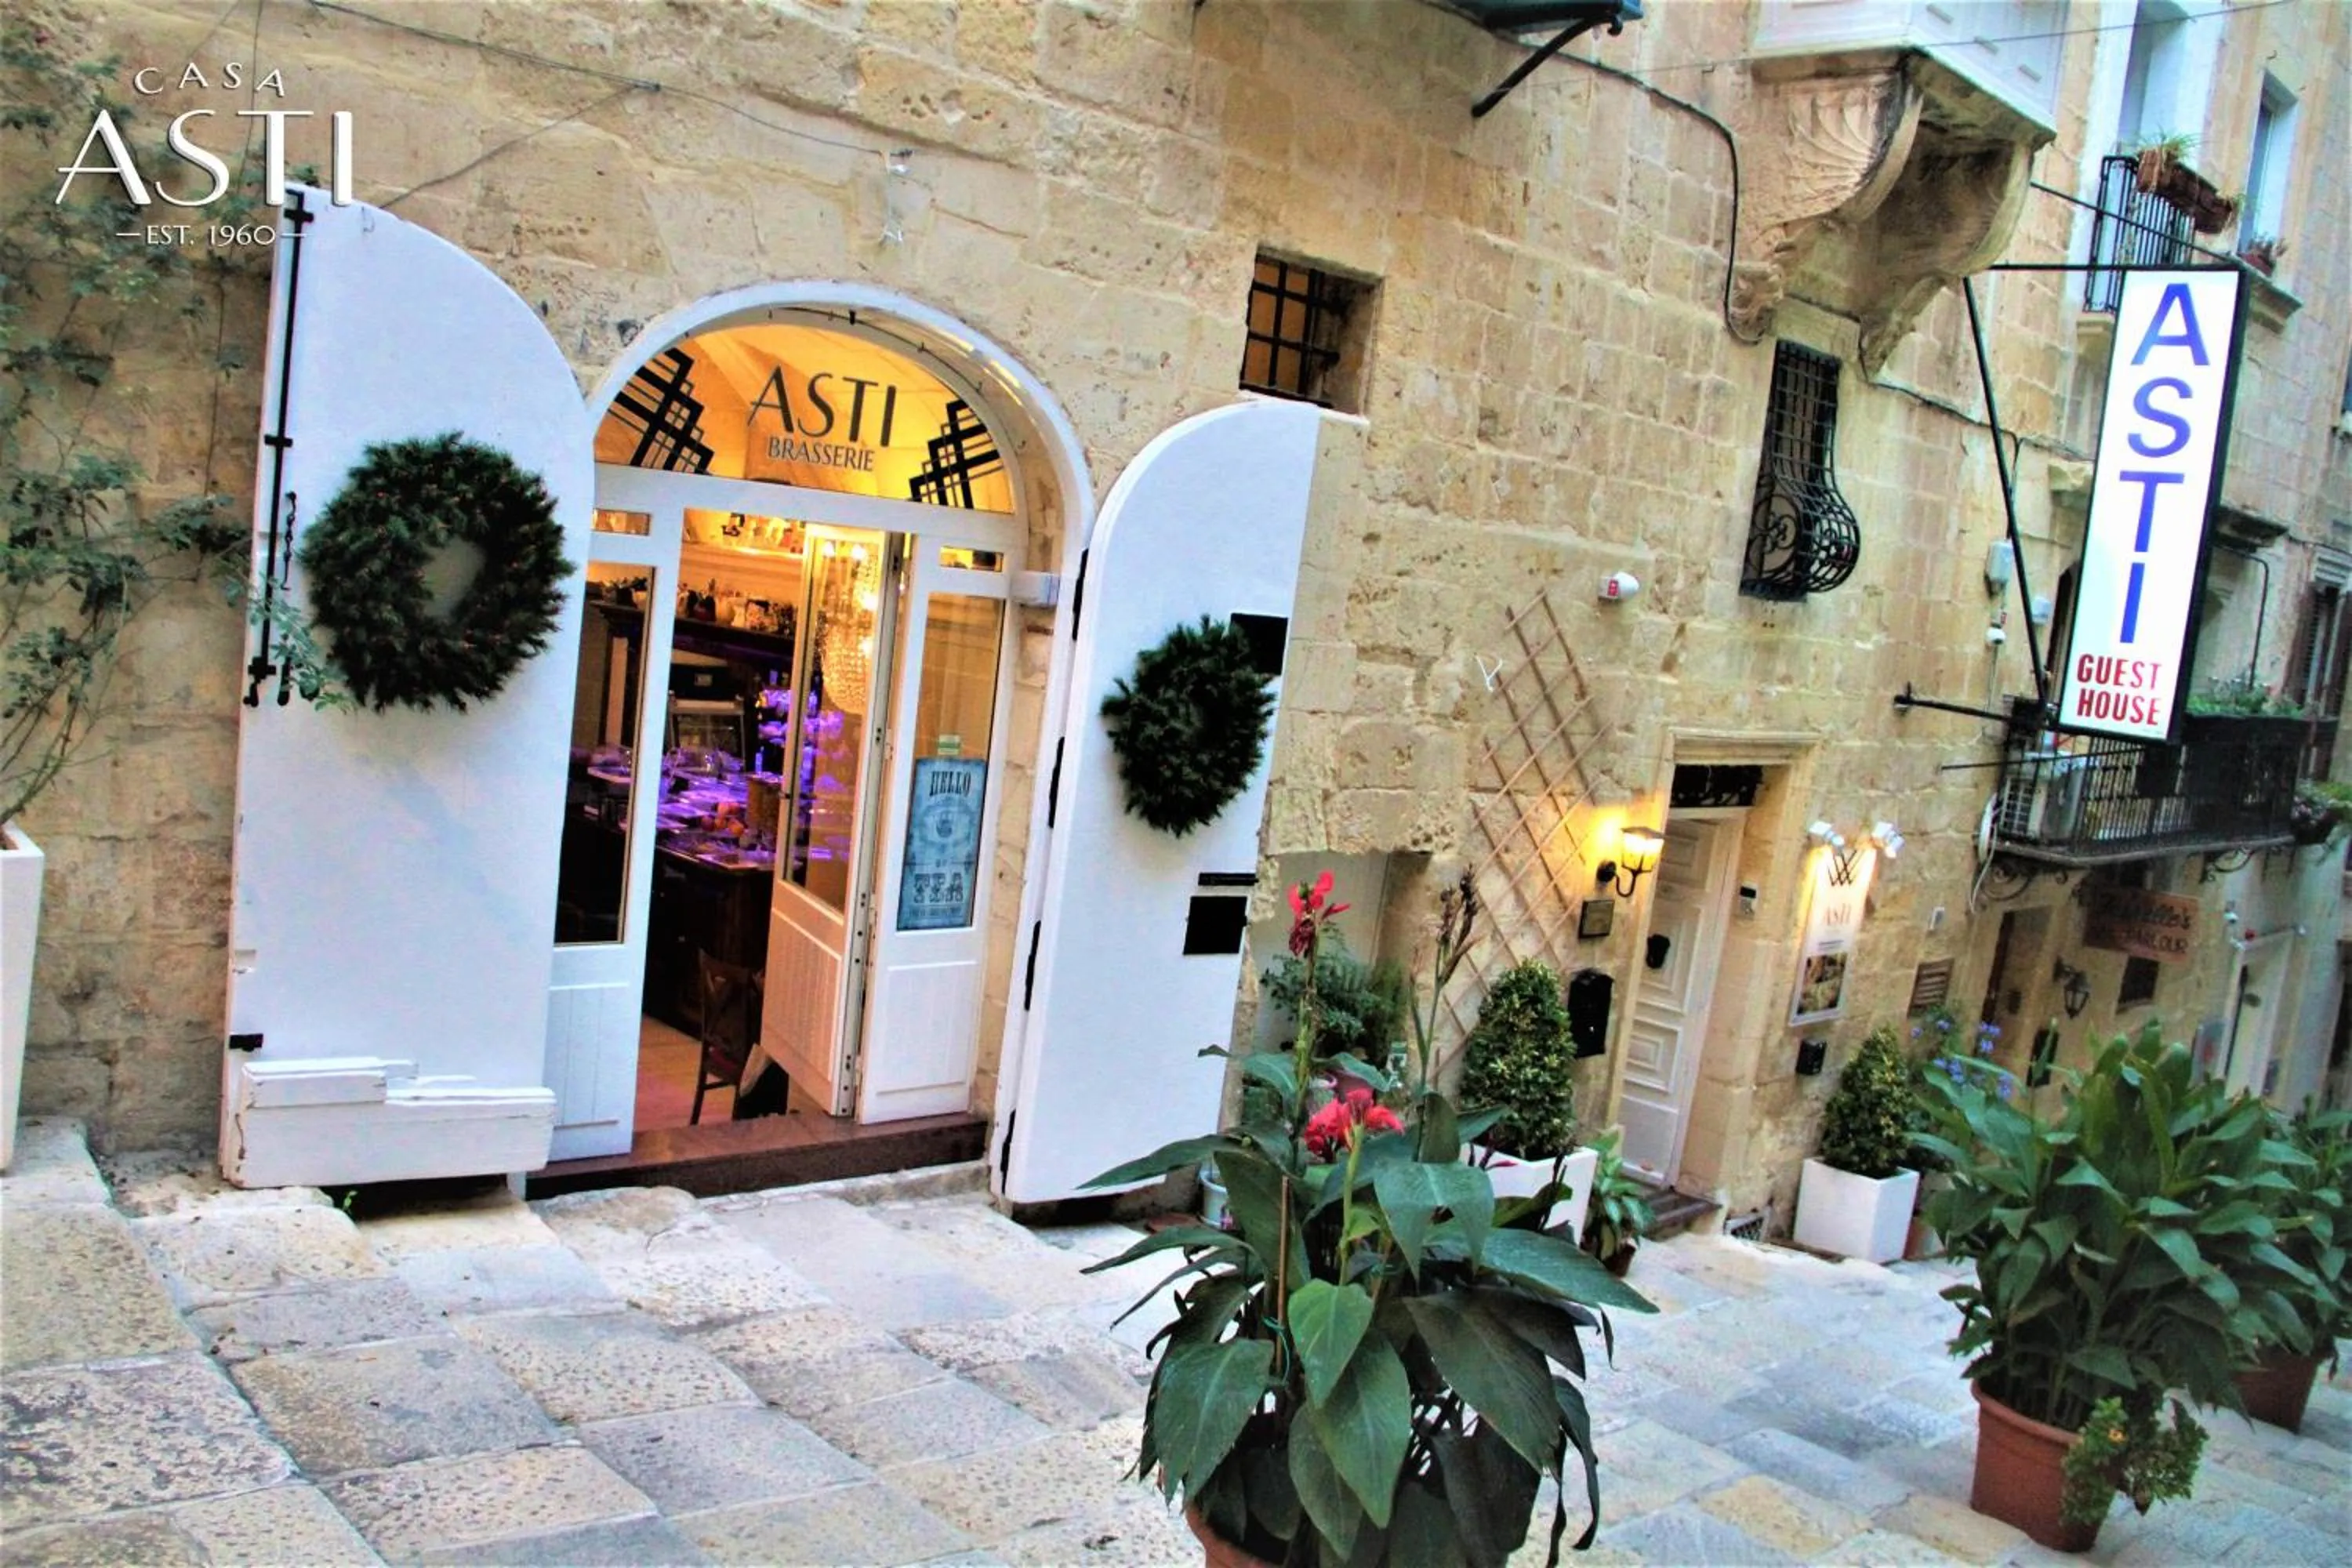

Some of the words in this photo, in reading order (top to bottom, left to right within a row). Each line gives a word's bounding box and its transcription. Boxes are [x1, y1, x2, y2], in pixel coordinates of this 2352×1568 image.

[747, 365, 896, 447] ASTI
[768, 436, 875, 471] BRASSERIE
[2119, 282, 2210, 644] ASTI
[2077, 653, 2162, 690] GUEST
[2077, 688, 2161, 726] HOUSE
[929, 771, 971, 797] HELLO
